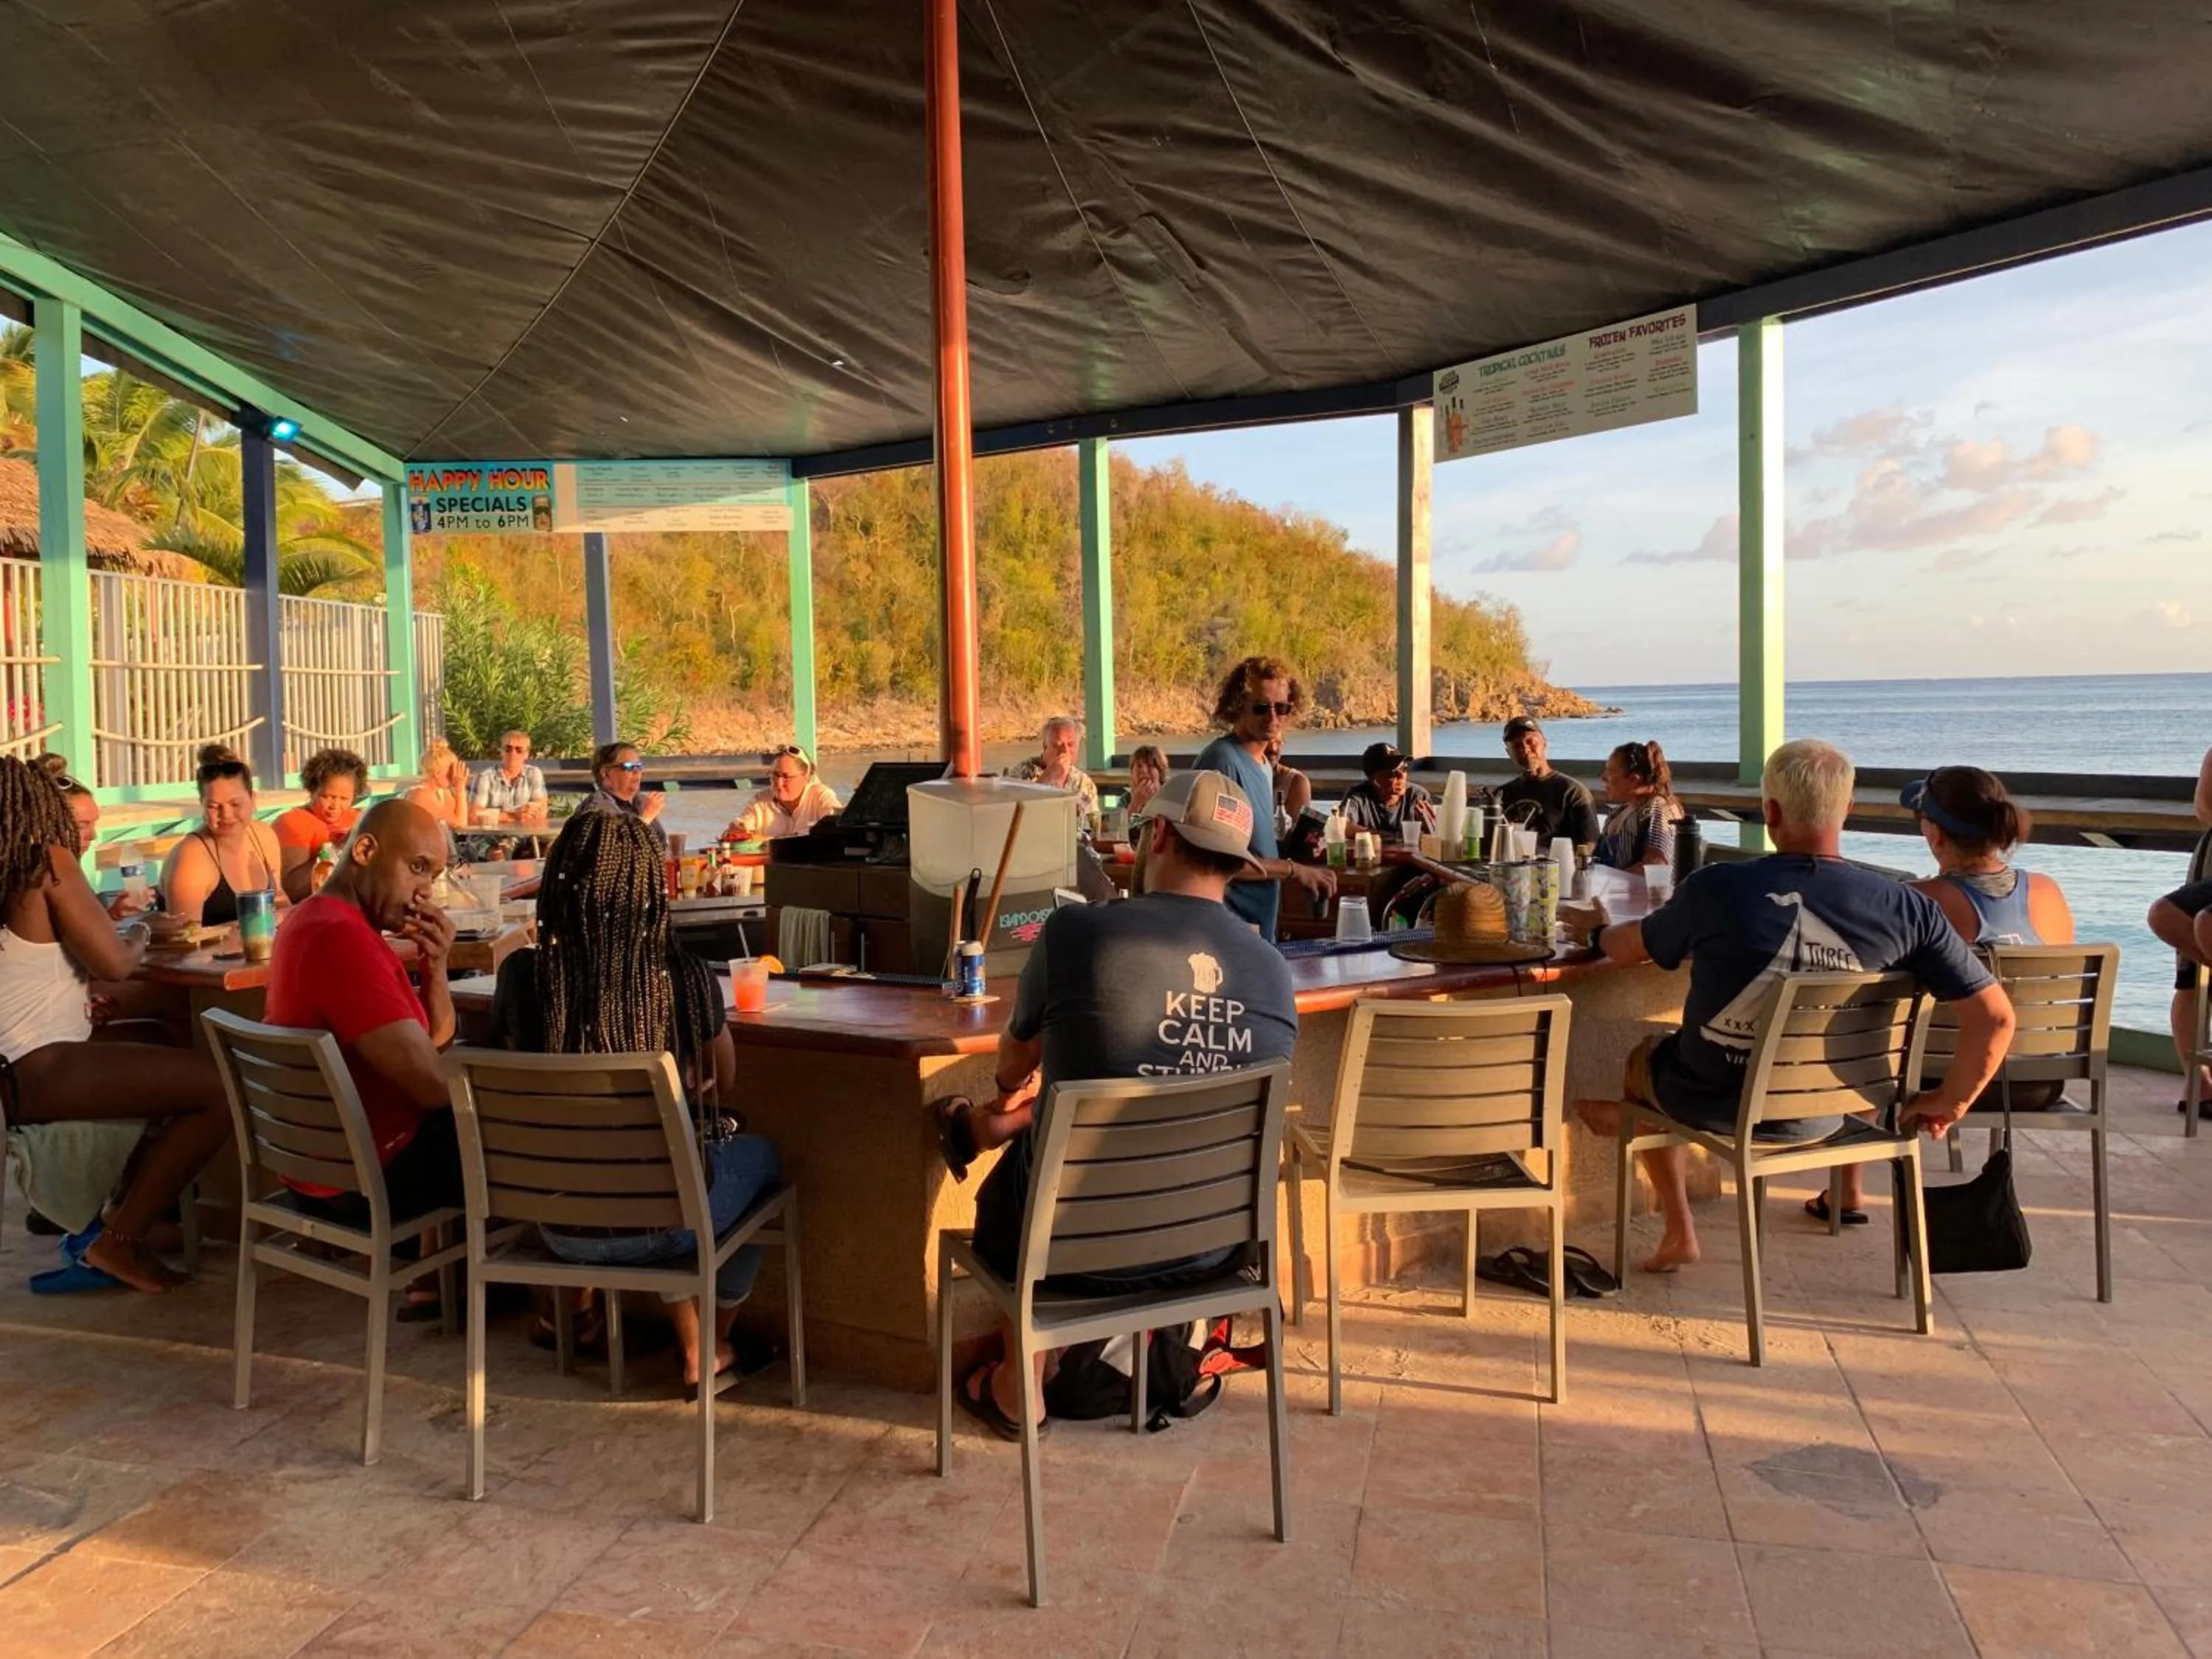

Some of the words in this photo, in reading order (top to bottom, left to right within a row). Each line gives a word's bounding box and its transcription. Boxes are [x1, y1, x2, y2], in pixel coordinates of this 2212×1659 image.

[1589, 330, 1626, 349] FROZEN
[1628, 313, 1686, 338] FAVORITES
[1478, 357, 1517, 378] TROPICAL
[1518, 343, 1566, 366] COCKTAILS
[409, 468, 481, 492] HAPPY
[489, 467, 550, 490] HOUR
[437, 496, 526, 512] SPECIALS
[437, 516, 468, 529] 4PM
[476, 518, 490, 529] to
[498, 515, 529, 528] 6PM
[1805, 942, 1852, 970] THREE
[1166, 990, 1245, 1024] KEEP
[1158, 1019, 1252, 1054] CALM
[1180, 1050, 1228, 1069] AND
